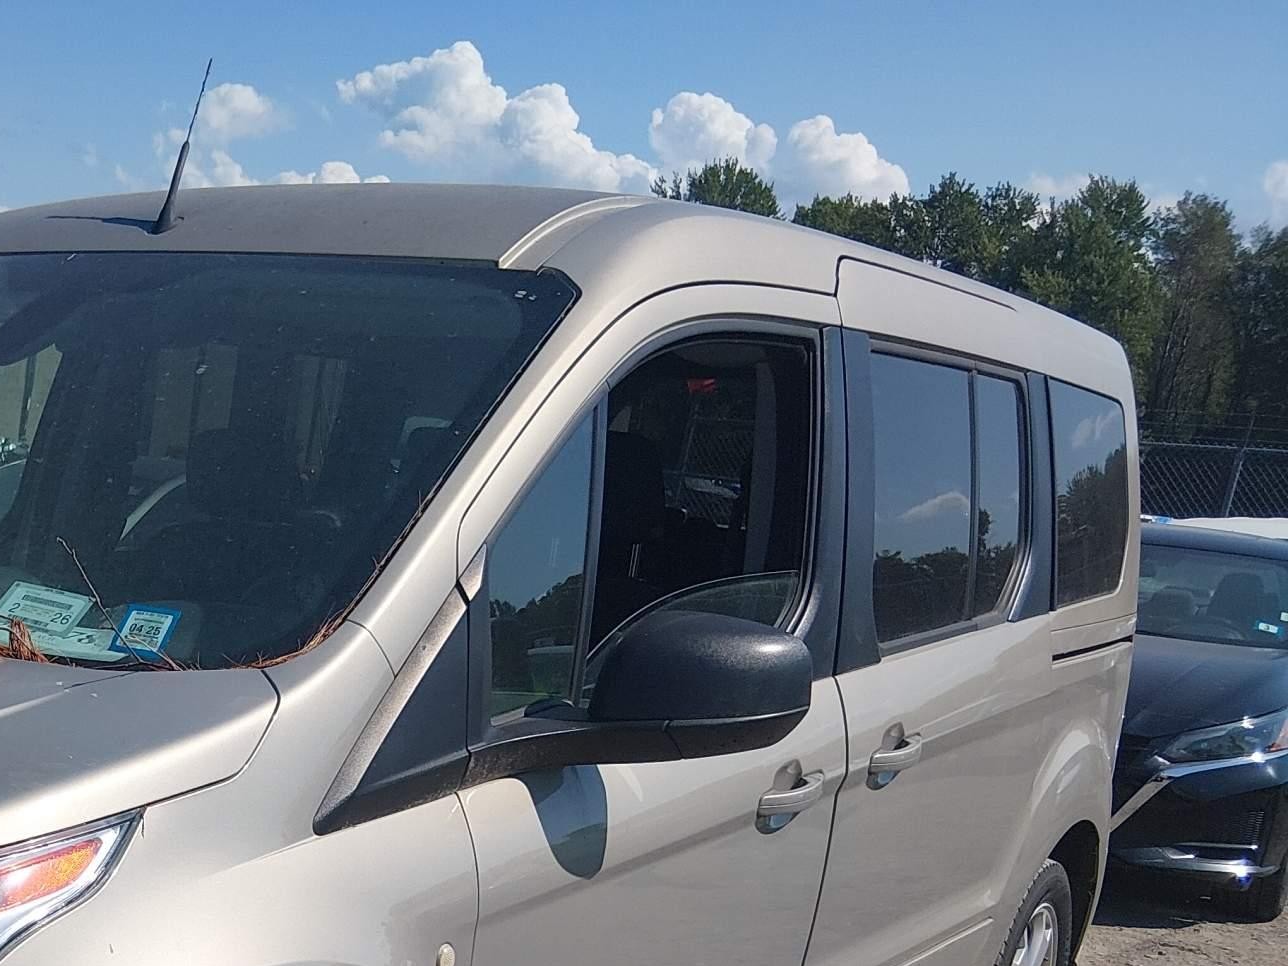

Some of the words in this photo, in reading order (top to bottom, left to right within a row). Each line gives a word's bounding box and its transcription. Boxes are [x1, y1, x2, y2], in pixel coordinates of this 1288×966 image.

[8, 602, 21, 613] 2
[51, 612, 72, 625] 26
[129, 623, 144, 633] 04
[145, 625, 162, 636] 25
